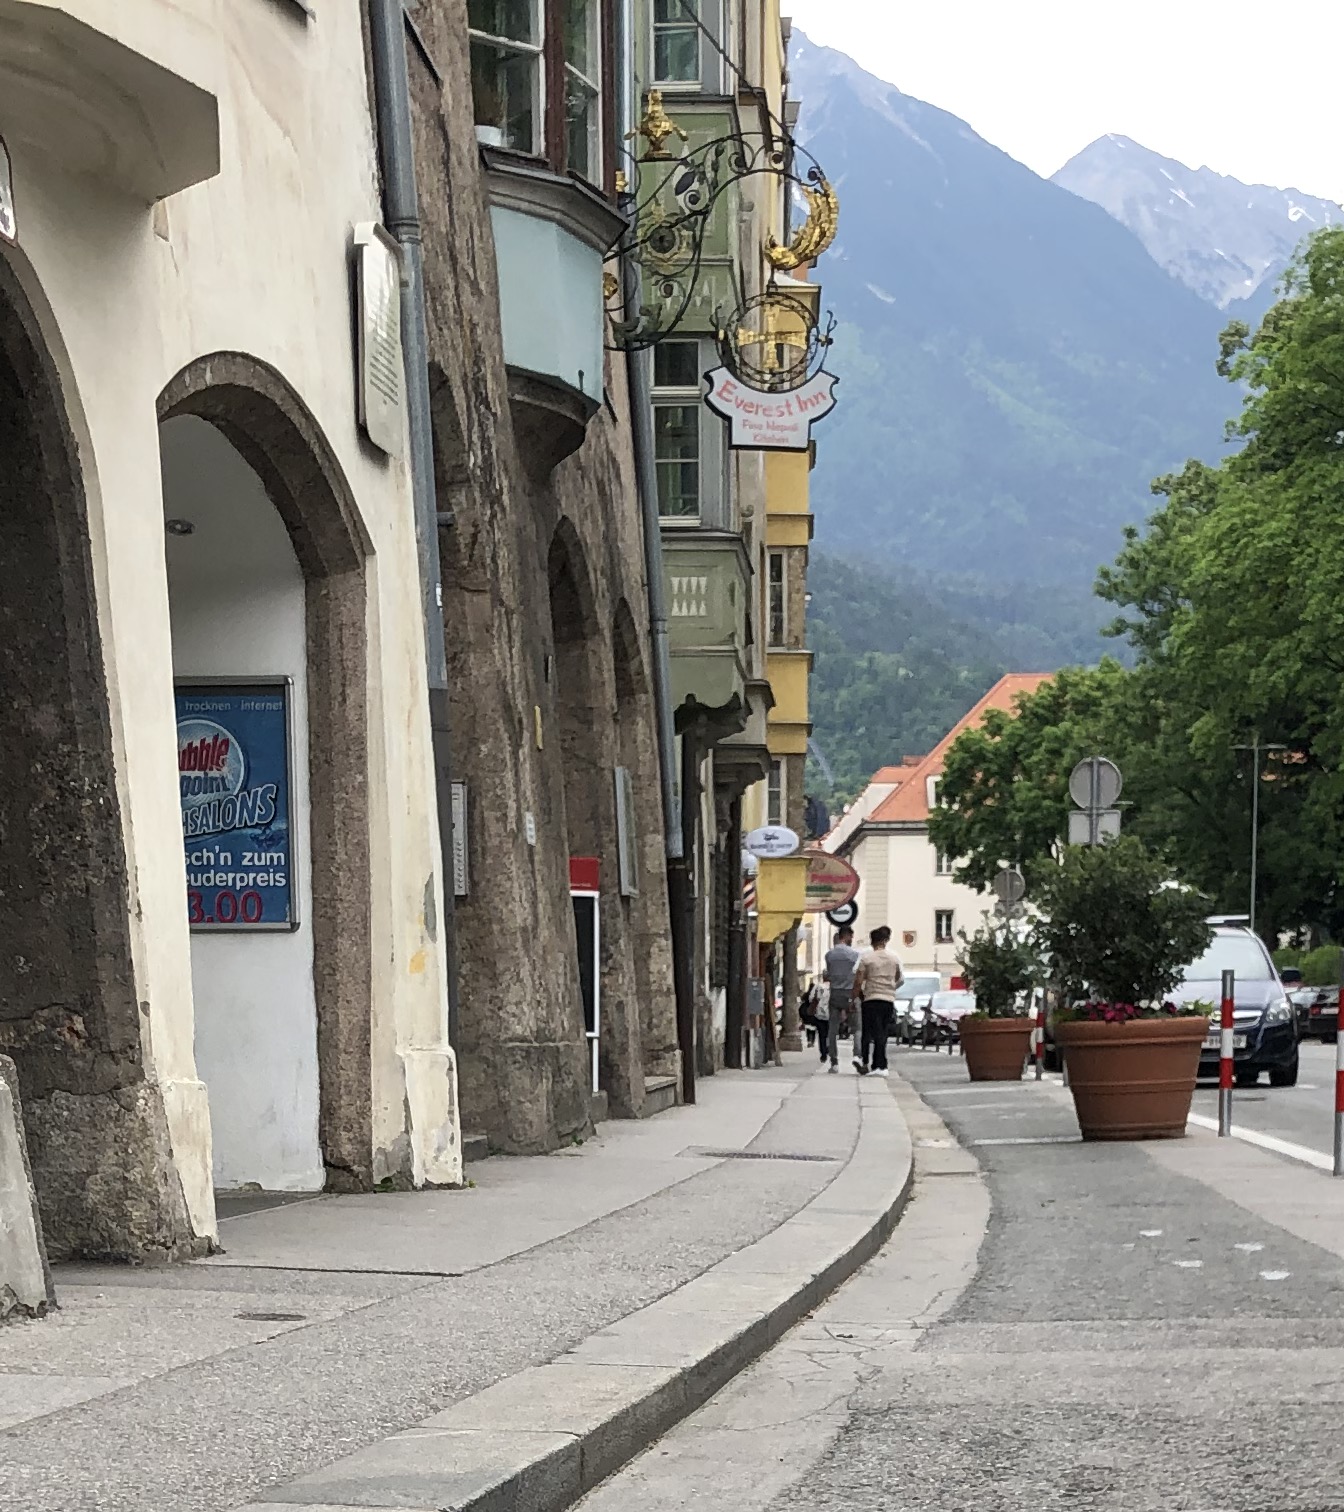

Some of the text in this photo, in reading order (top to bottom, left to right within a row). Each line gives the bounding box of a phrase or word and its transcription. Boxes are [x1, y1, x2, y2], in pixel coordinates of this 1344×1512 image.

[717, 380, 827, 418] Everest Inn
[185, 699, 283, 711] trocknen internet
[241, 851, 285, 866] zum
[187, 868, 287, 891] uderpreis
